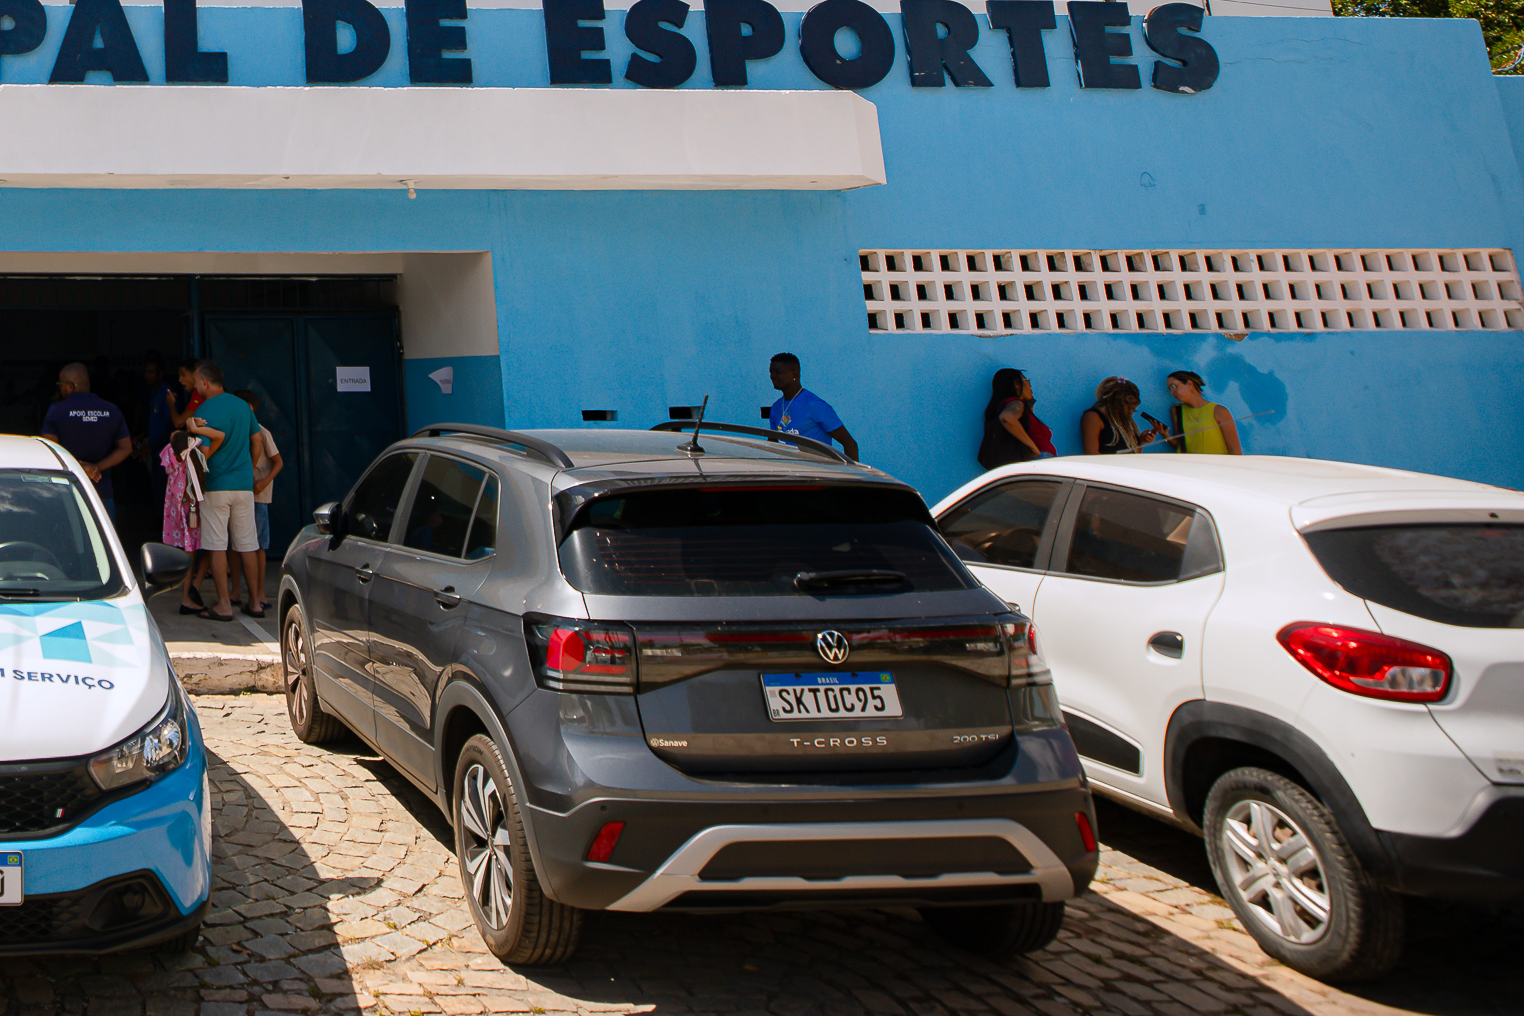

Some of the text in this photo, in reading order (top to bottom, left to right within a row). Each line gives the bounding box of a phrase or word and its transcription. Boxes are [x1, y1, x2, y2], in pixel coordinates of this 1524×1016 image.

[12, 669, 115, 690] SERVIÇO
[778, 686, 886, 714] SKT0C95
[659, 738, 688, 747] Sanave
[789, 736, 888, 748] T-CROSS
[952, 733, 999, 743] 200 TSI
